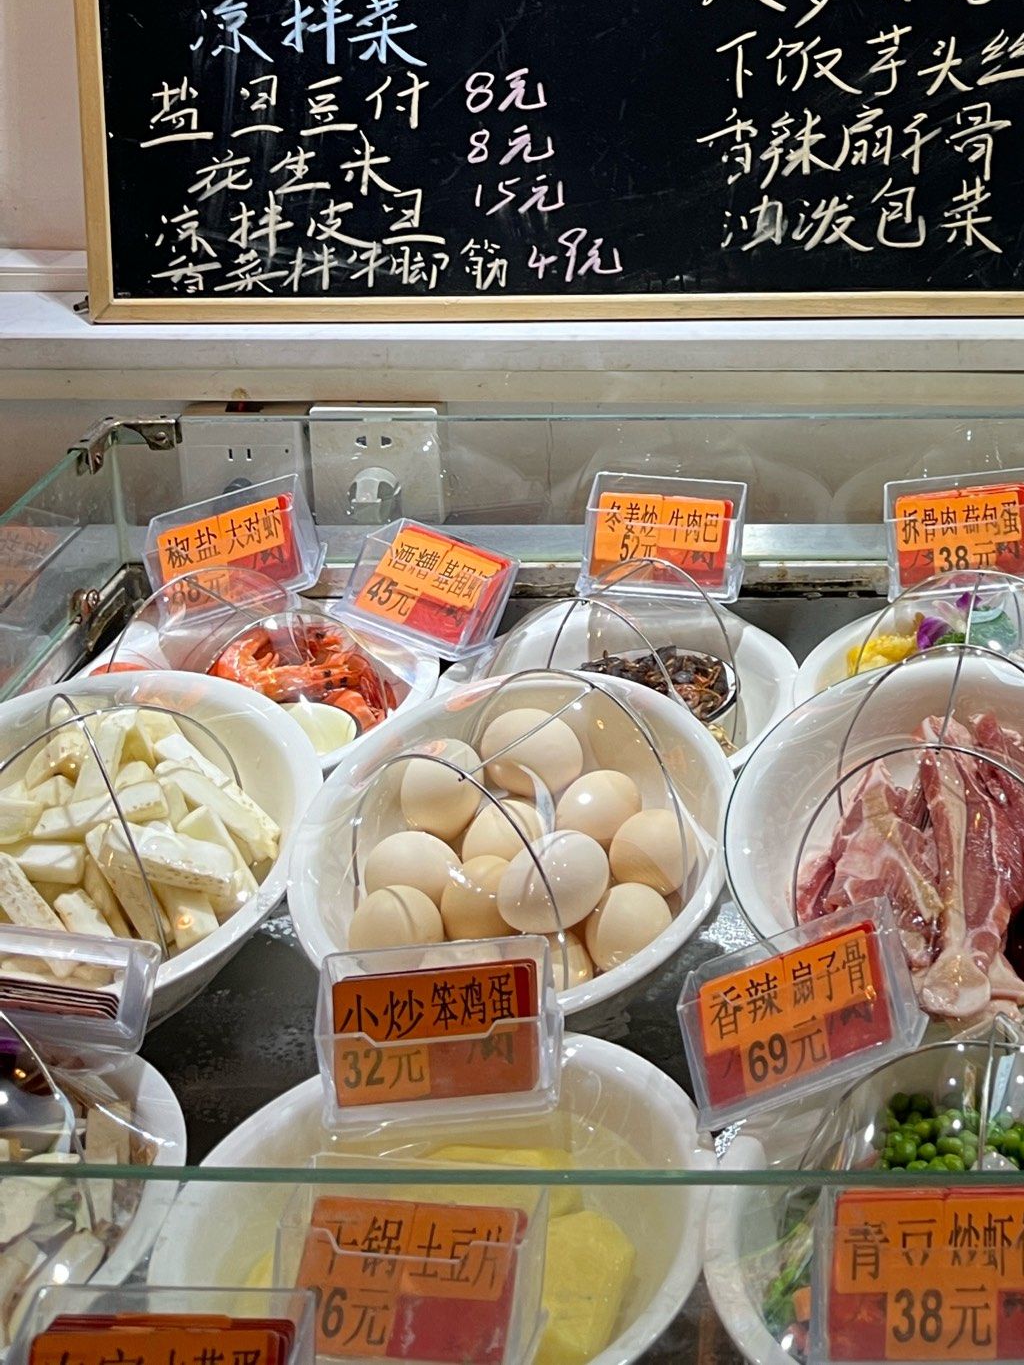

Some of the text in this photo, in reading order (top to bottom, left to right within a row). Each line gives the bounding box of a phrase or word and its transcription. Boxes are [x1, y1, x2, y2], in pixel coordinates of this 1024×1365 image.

[939, 542, 996, 573] 38元
[365, 577, 416, 618] 45元
[339, 972, 516, 1040] 小炒笨鸡蛋
[709, 942, 868, 1039] 香辣扇子骨
[341, 1046, 425, 1089] 32元
[747, 1020, 830, 1082] 69元
[892, 1285, 991, 1349] 38元
